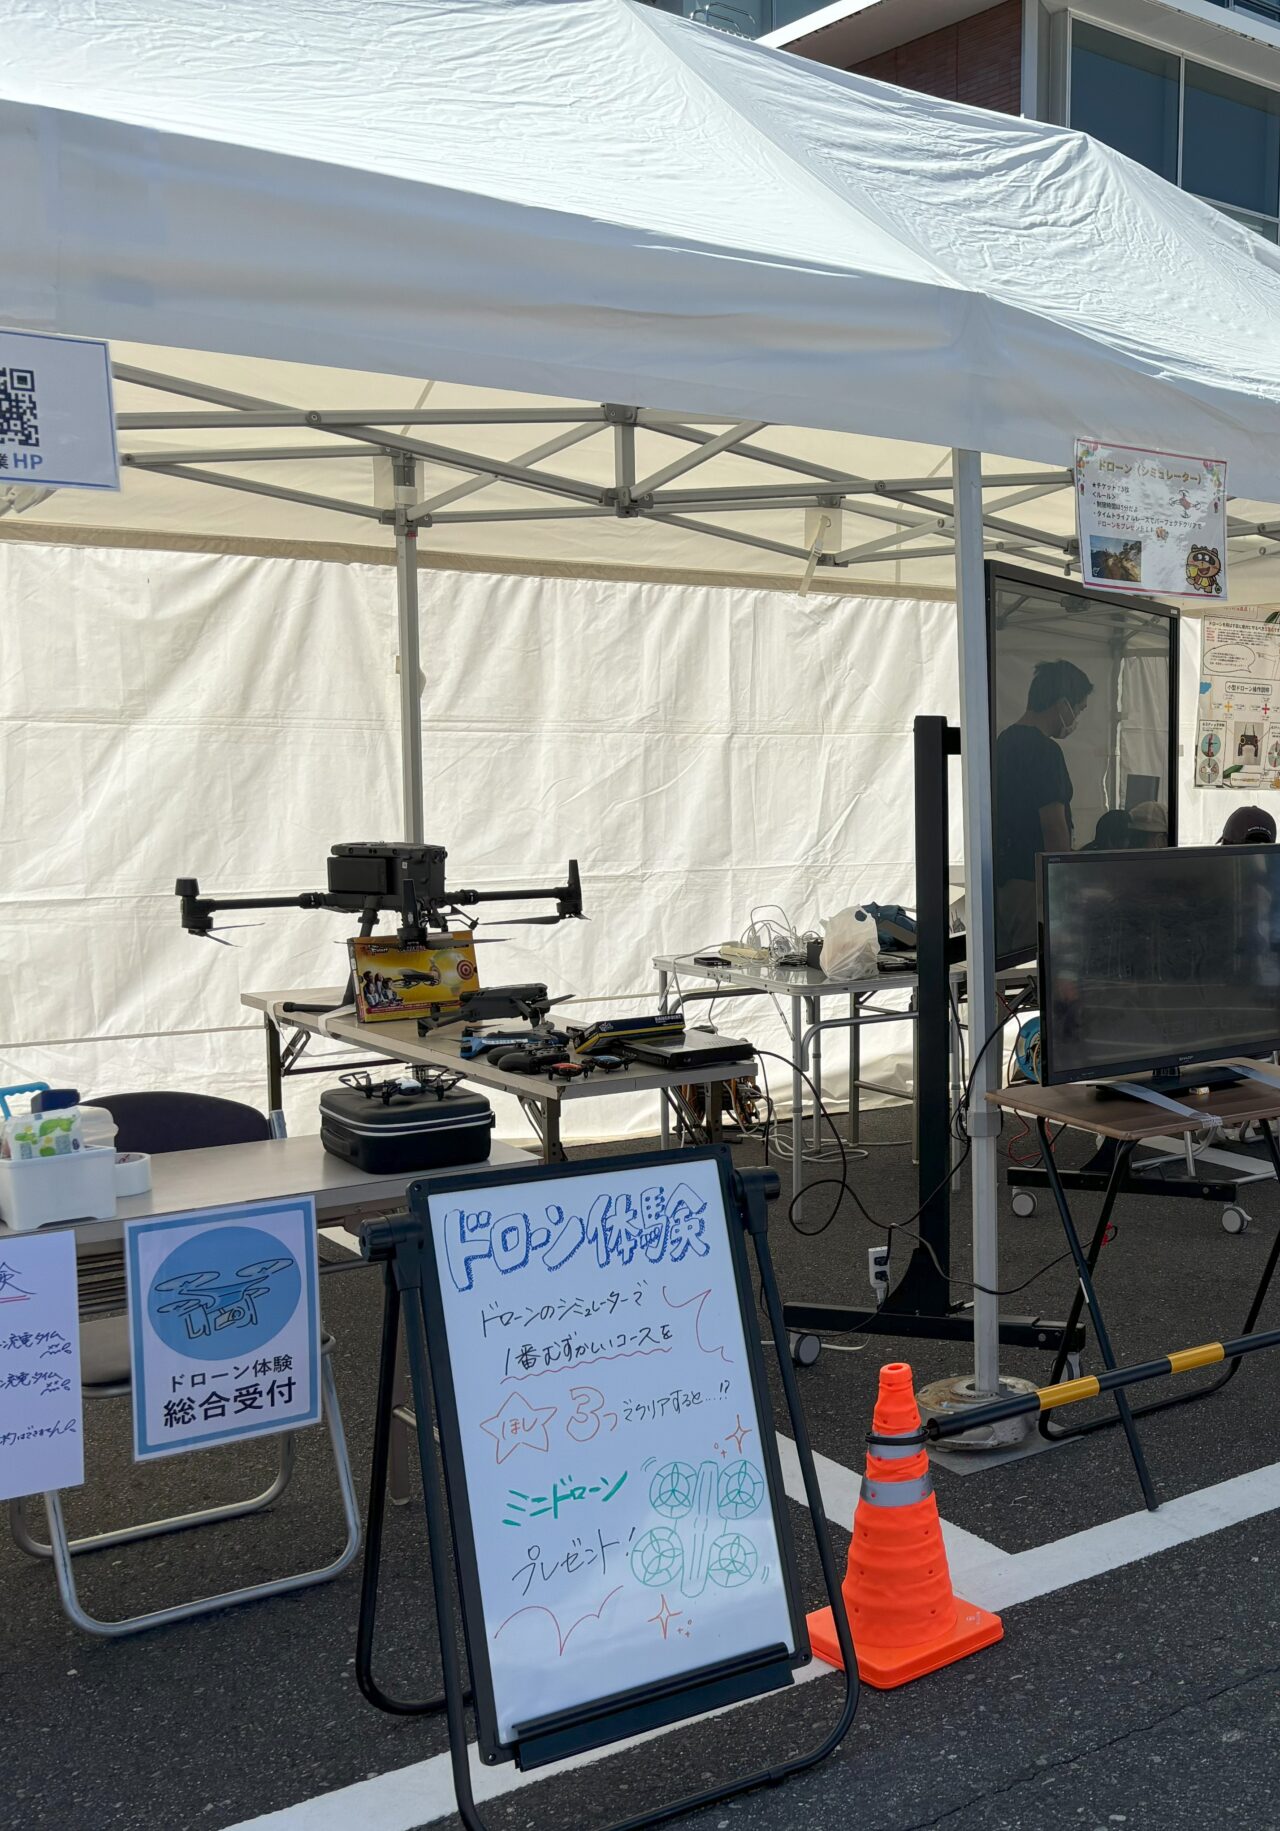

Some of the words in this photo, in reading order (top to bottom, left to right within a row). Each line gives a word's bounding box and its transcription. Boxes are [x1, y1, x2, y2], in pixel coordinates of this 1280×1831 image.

[444, 1182, 711, 1293] ドローン体験
[171, 1354, 294, 1392] ドローン体験
[162, 1376, 297, 1429] 総合受付
[502, 1470, 628, 1526] ミニドローン
